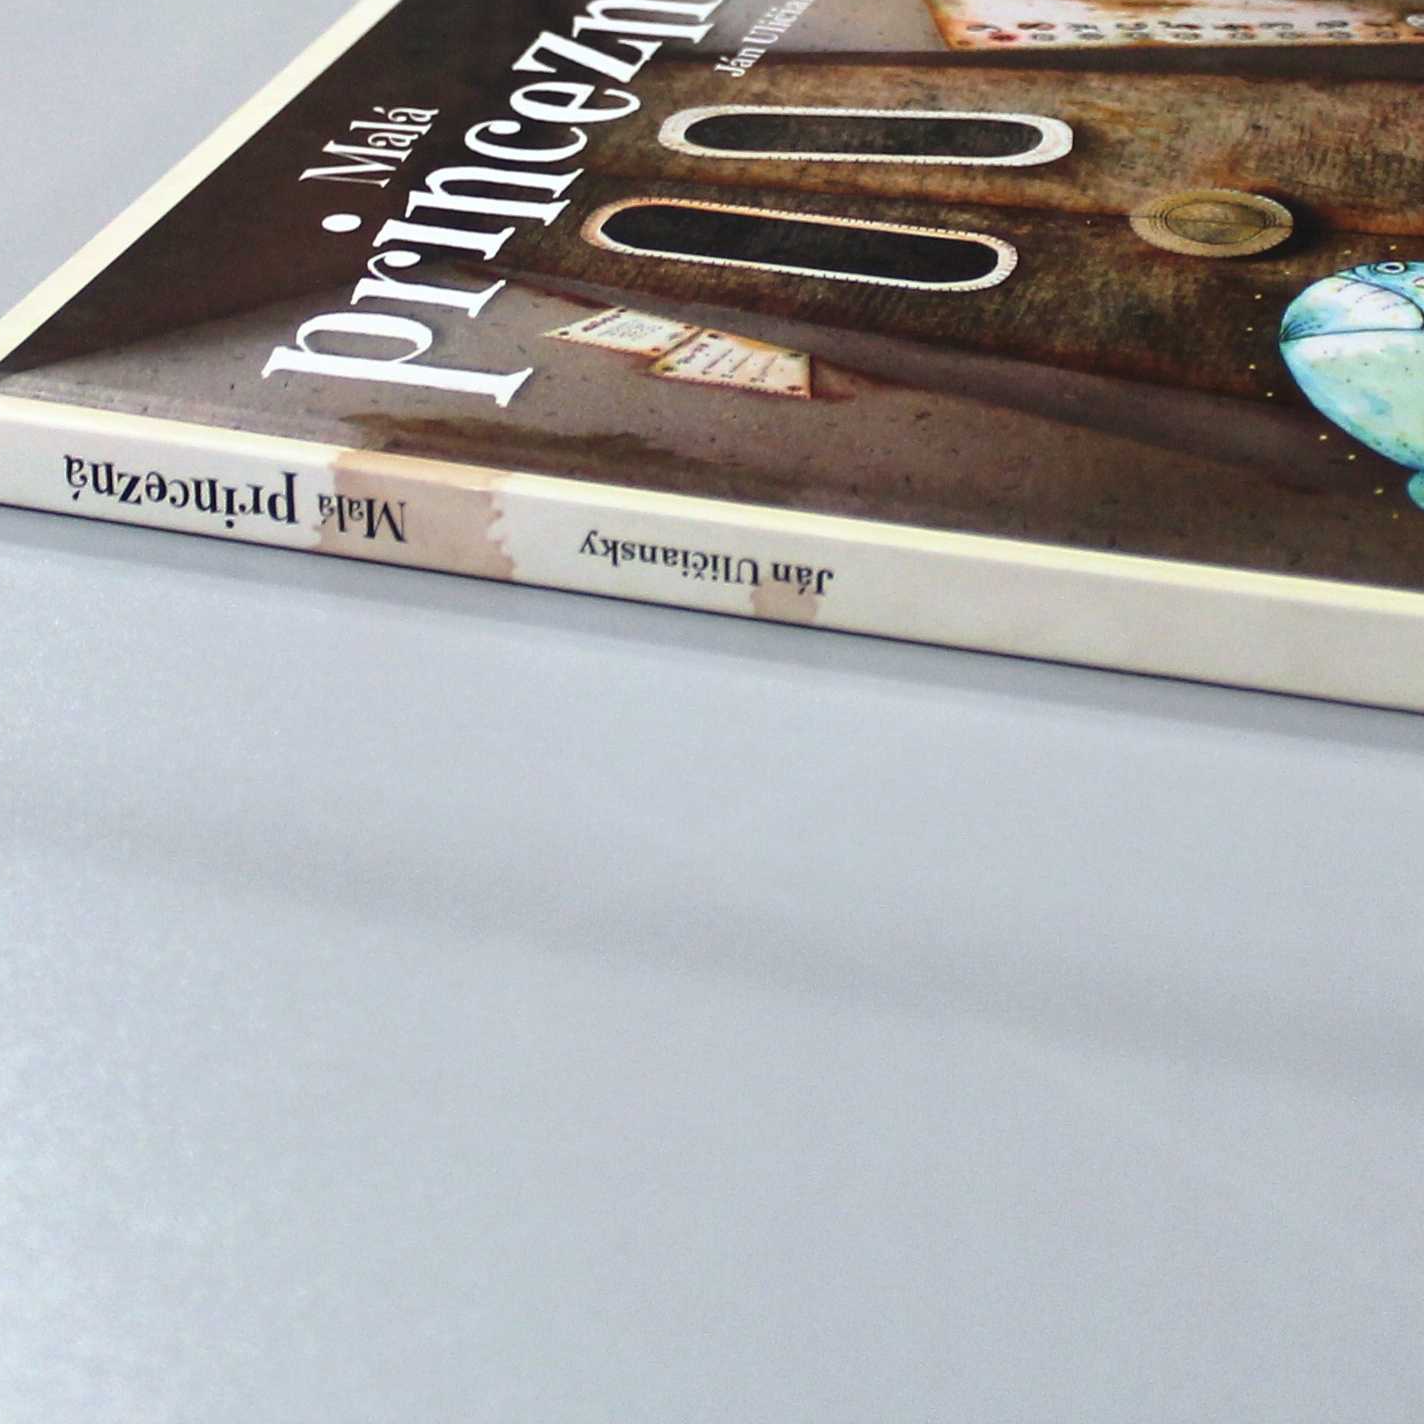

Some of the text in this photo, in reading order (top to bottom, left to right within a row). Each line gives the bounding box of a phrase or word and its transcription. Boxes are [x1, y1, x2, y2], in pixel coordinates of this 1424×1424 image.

[714, 45, 766, 77] Ján
[299, 105, 439, 188] Malá
[64, 453, 408, 543] Malá princezná
[579, 528, 834, 597] Ján Uličiansky
